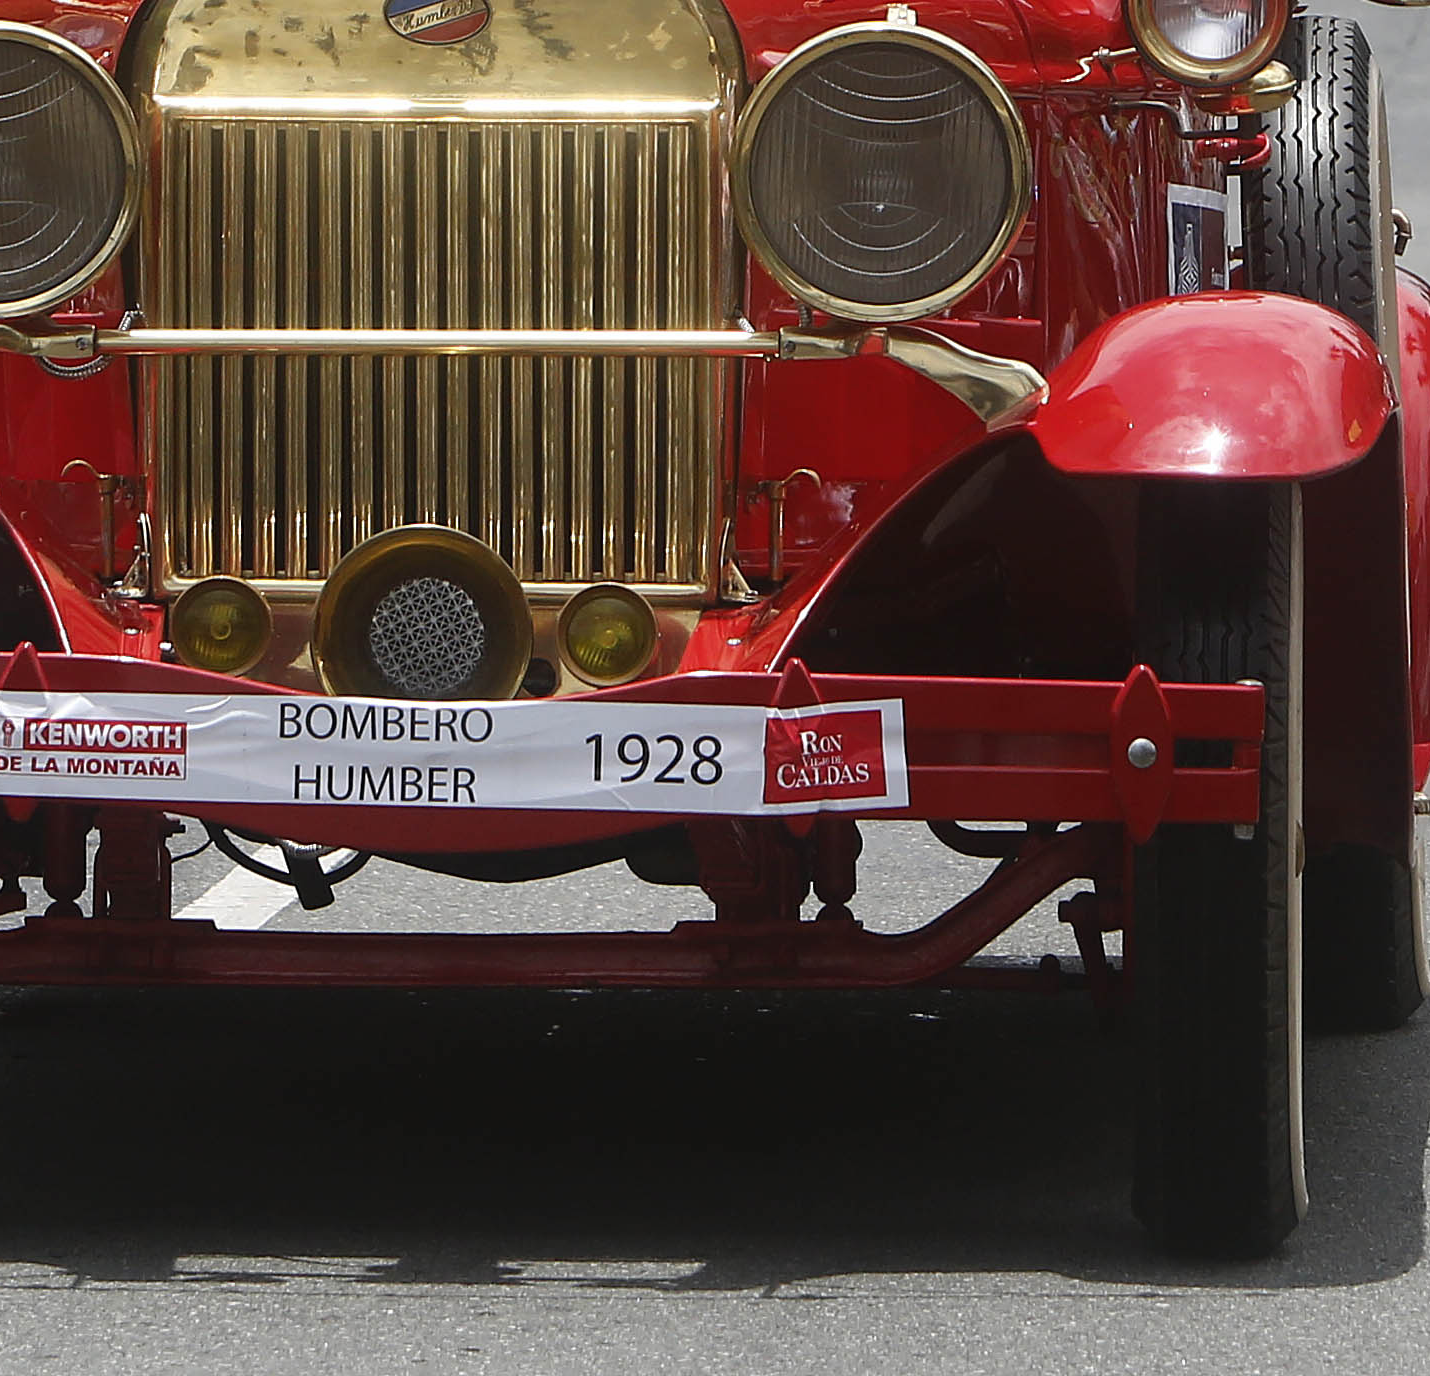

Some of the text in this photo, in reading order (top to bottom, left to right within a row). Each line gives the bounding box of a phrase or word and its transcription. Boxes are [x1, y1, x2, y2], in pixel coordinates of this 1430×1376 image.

[29, 722, 183, 749] KENWORTH
[278, 703, 493, 743] BOMBERO
[31, 757, 59, 773] LA
[67, 756, 181, 776] MONTAÑA
[585, 733, 723, 785] 1928
[776, 763, 870, 788] CALDAS
[293, 764, 477, 803] HUMBER
